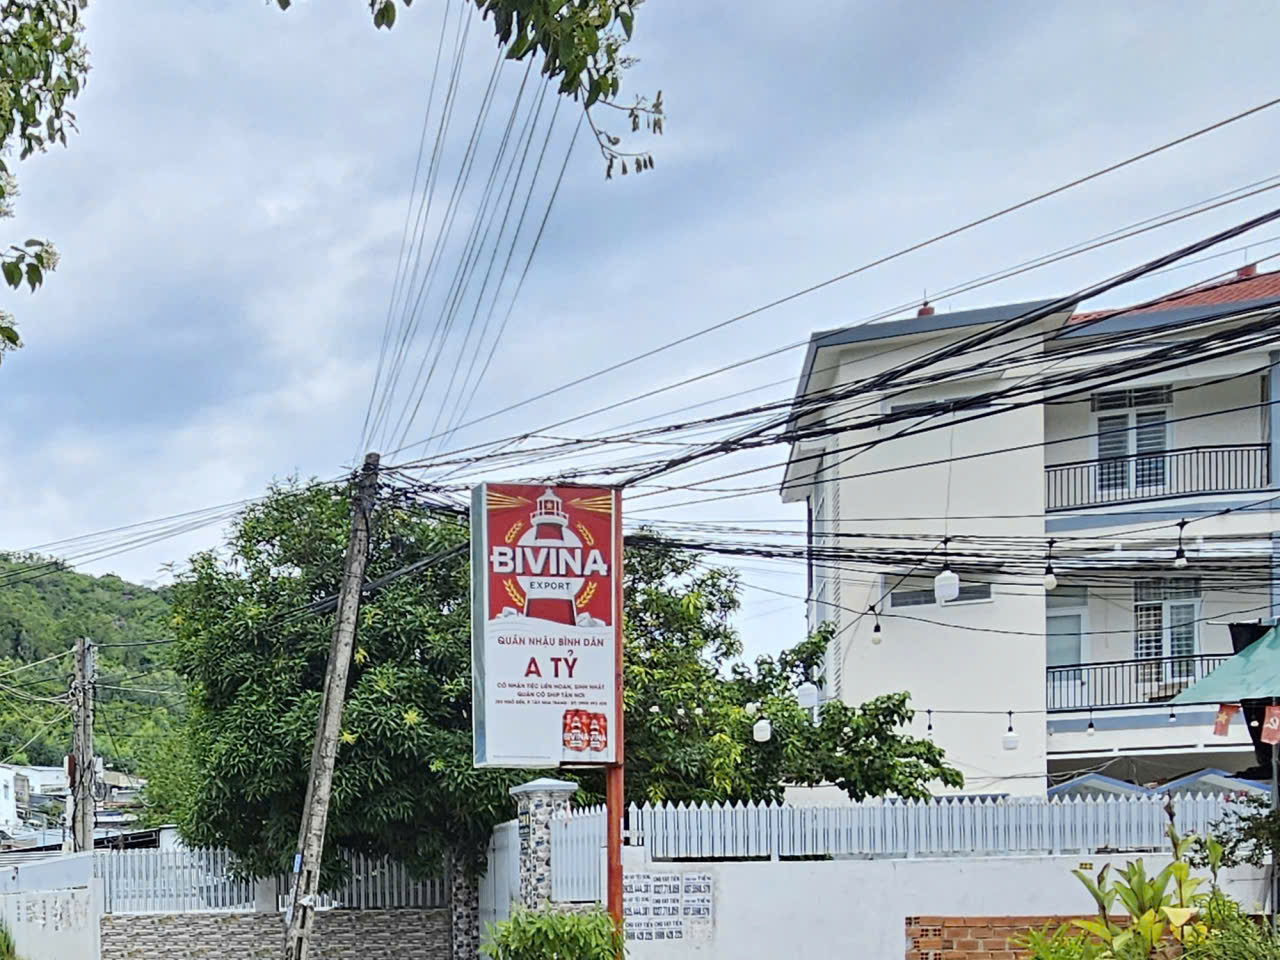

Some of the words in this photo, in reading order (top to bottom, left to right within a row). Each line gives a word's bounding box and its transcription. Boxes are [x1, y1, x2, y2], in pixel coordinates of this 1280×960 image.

[489, 545, 608, 576] BIVINA
[529, 581, 571, 591] EXPORT
[558, 635, 581, 646] BÌNH
[583, 636, 604, 647] DÂN
[524, 656, 542, 678] A
[550, 649, 578, 678] TỶ
